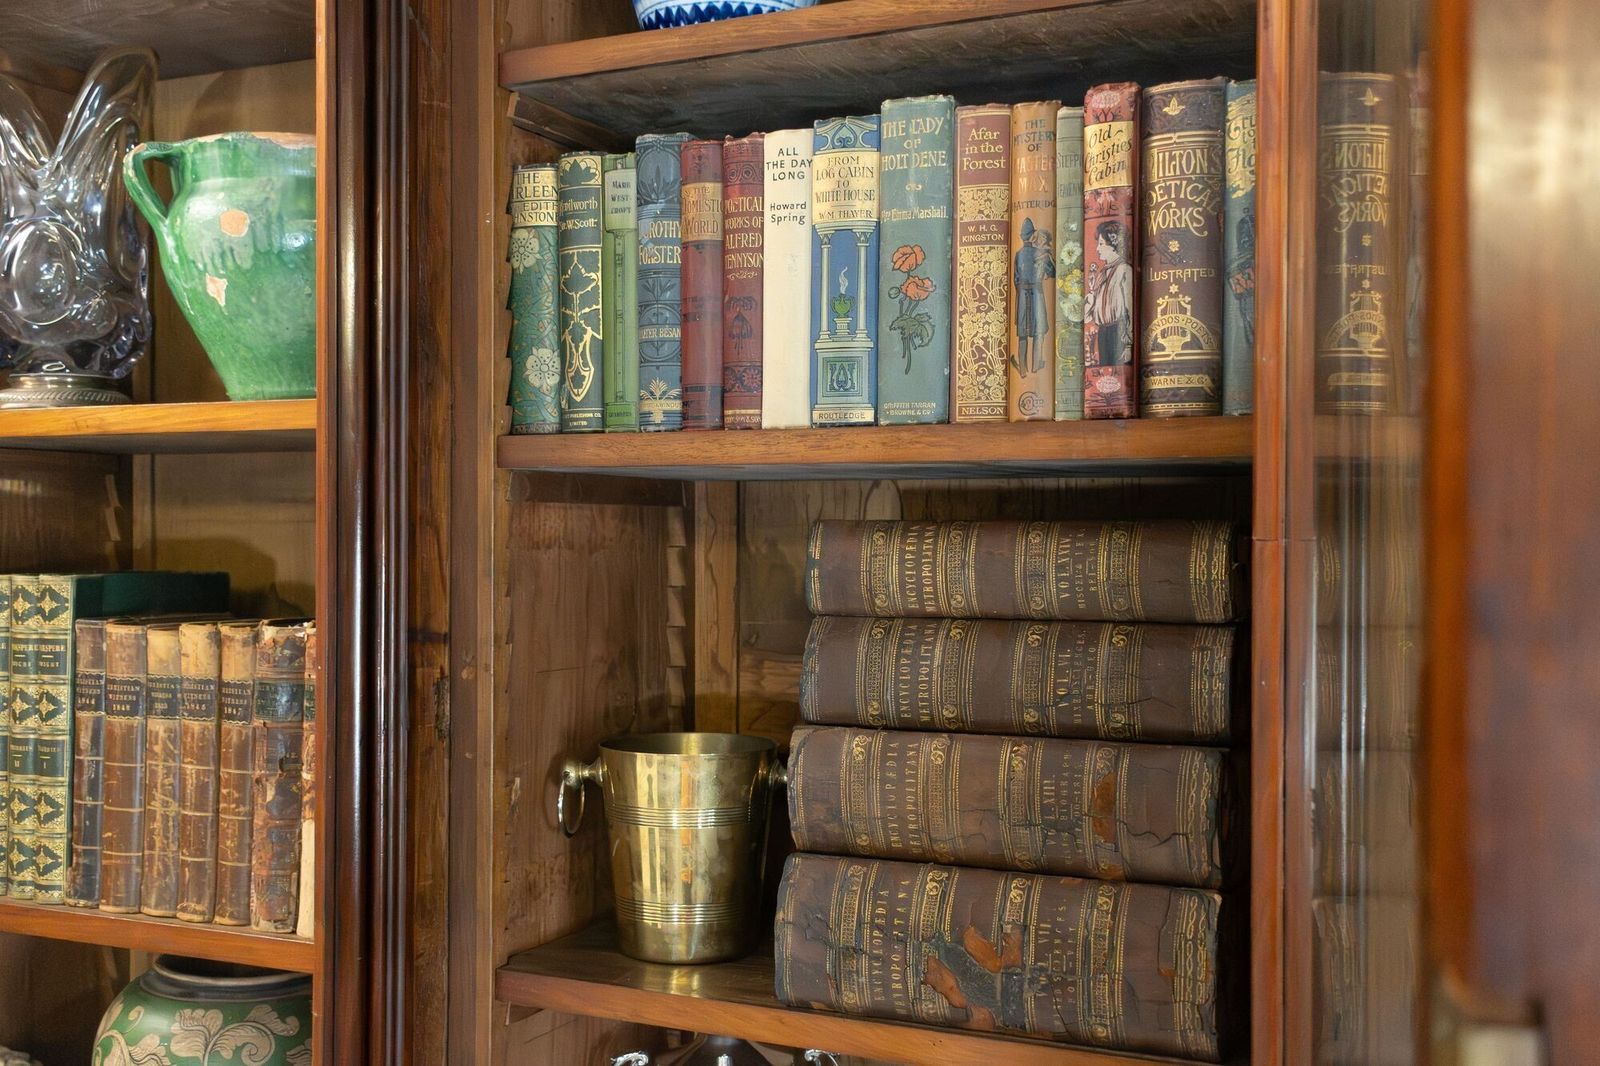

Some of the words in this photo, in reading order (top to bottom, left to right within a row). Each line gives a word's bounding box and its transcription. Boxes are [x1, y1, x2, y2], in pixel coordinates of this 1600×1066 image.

[882, 120, 906, 138] THE
[911, 117, 945, 134] LADY
[1025, 119, 1046, 130] THE
[968, 127, 1000, 140] Afar
[1088, 124, 1112, 149] Old
[904, 139, 921, 150] OF
[965, 144, 978, 154] in
[980, 142, 1004, 154] the
[1028, 144, 1042, 152] OF
[778, 147, 799, 157] ALL
[766, 160, 785, 170] THE
[791, 159, 813, 168] DAY
[828, 156, 860, 166] FROM
[881, 154, 908, 171] HOLT
[912, 150, 947, 168] DENE
[962, 156, 1006, 170] Forest
[516, 172, 540, 185] THE
[772, 171, 805, 181] LONG
[816, 168, 835, 181] LOG
[838, 166, 874, 179] CABIN
[836, 180, 850, 188] TO
[512, 186, 559, 200] RLEEN
[815, 190, 841, 204] WHITE
[844, 189, 876, 201] HOUSE
[770, 202, 806, 212] Howard
[771, 213, 806, 226] Spring
[840, 210, 873, 218] THAYER
[1148, 201, 1208, 237] WORKS
[639, 221, 681, 238] ROTHY
[683, 218, 718, 234] WORLD
[725, 216, 750, 230] WORKS
[725, 233, 763, 250] ALFRED
[962, 233, 1004, 242] KINGSTON
[1150, 267, 1216, 282] LUSTRATED
[659, 327, 681, 338] BESAN
[1151, 376, 1183, 386] WARNE
[818, 412, 866, 420] ROUTLEDGE
[961, 406, 1004, 416] NELSON
[922, 525, 937, 612] METROPOLITANA
[918, 623, 938, 722] METROPOLITANA
